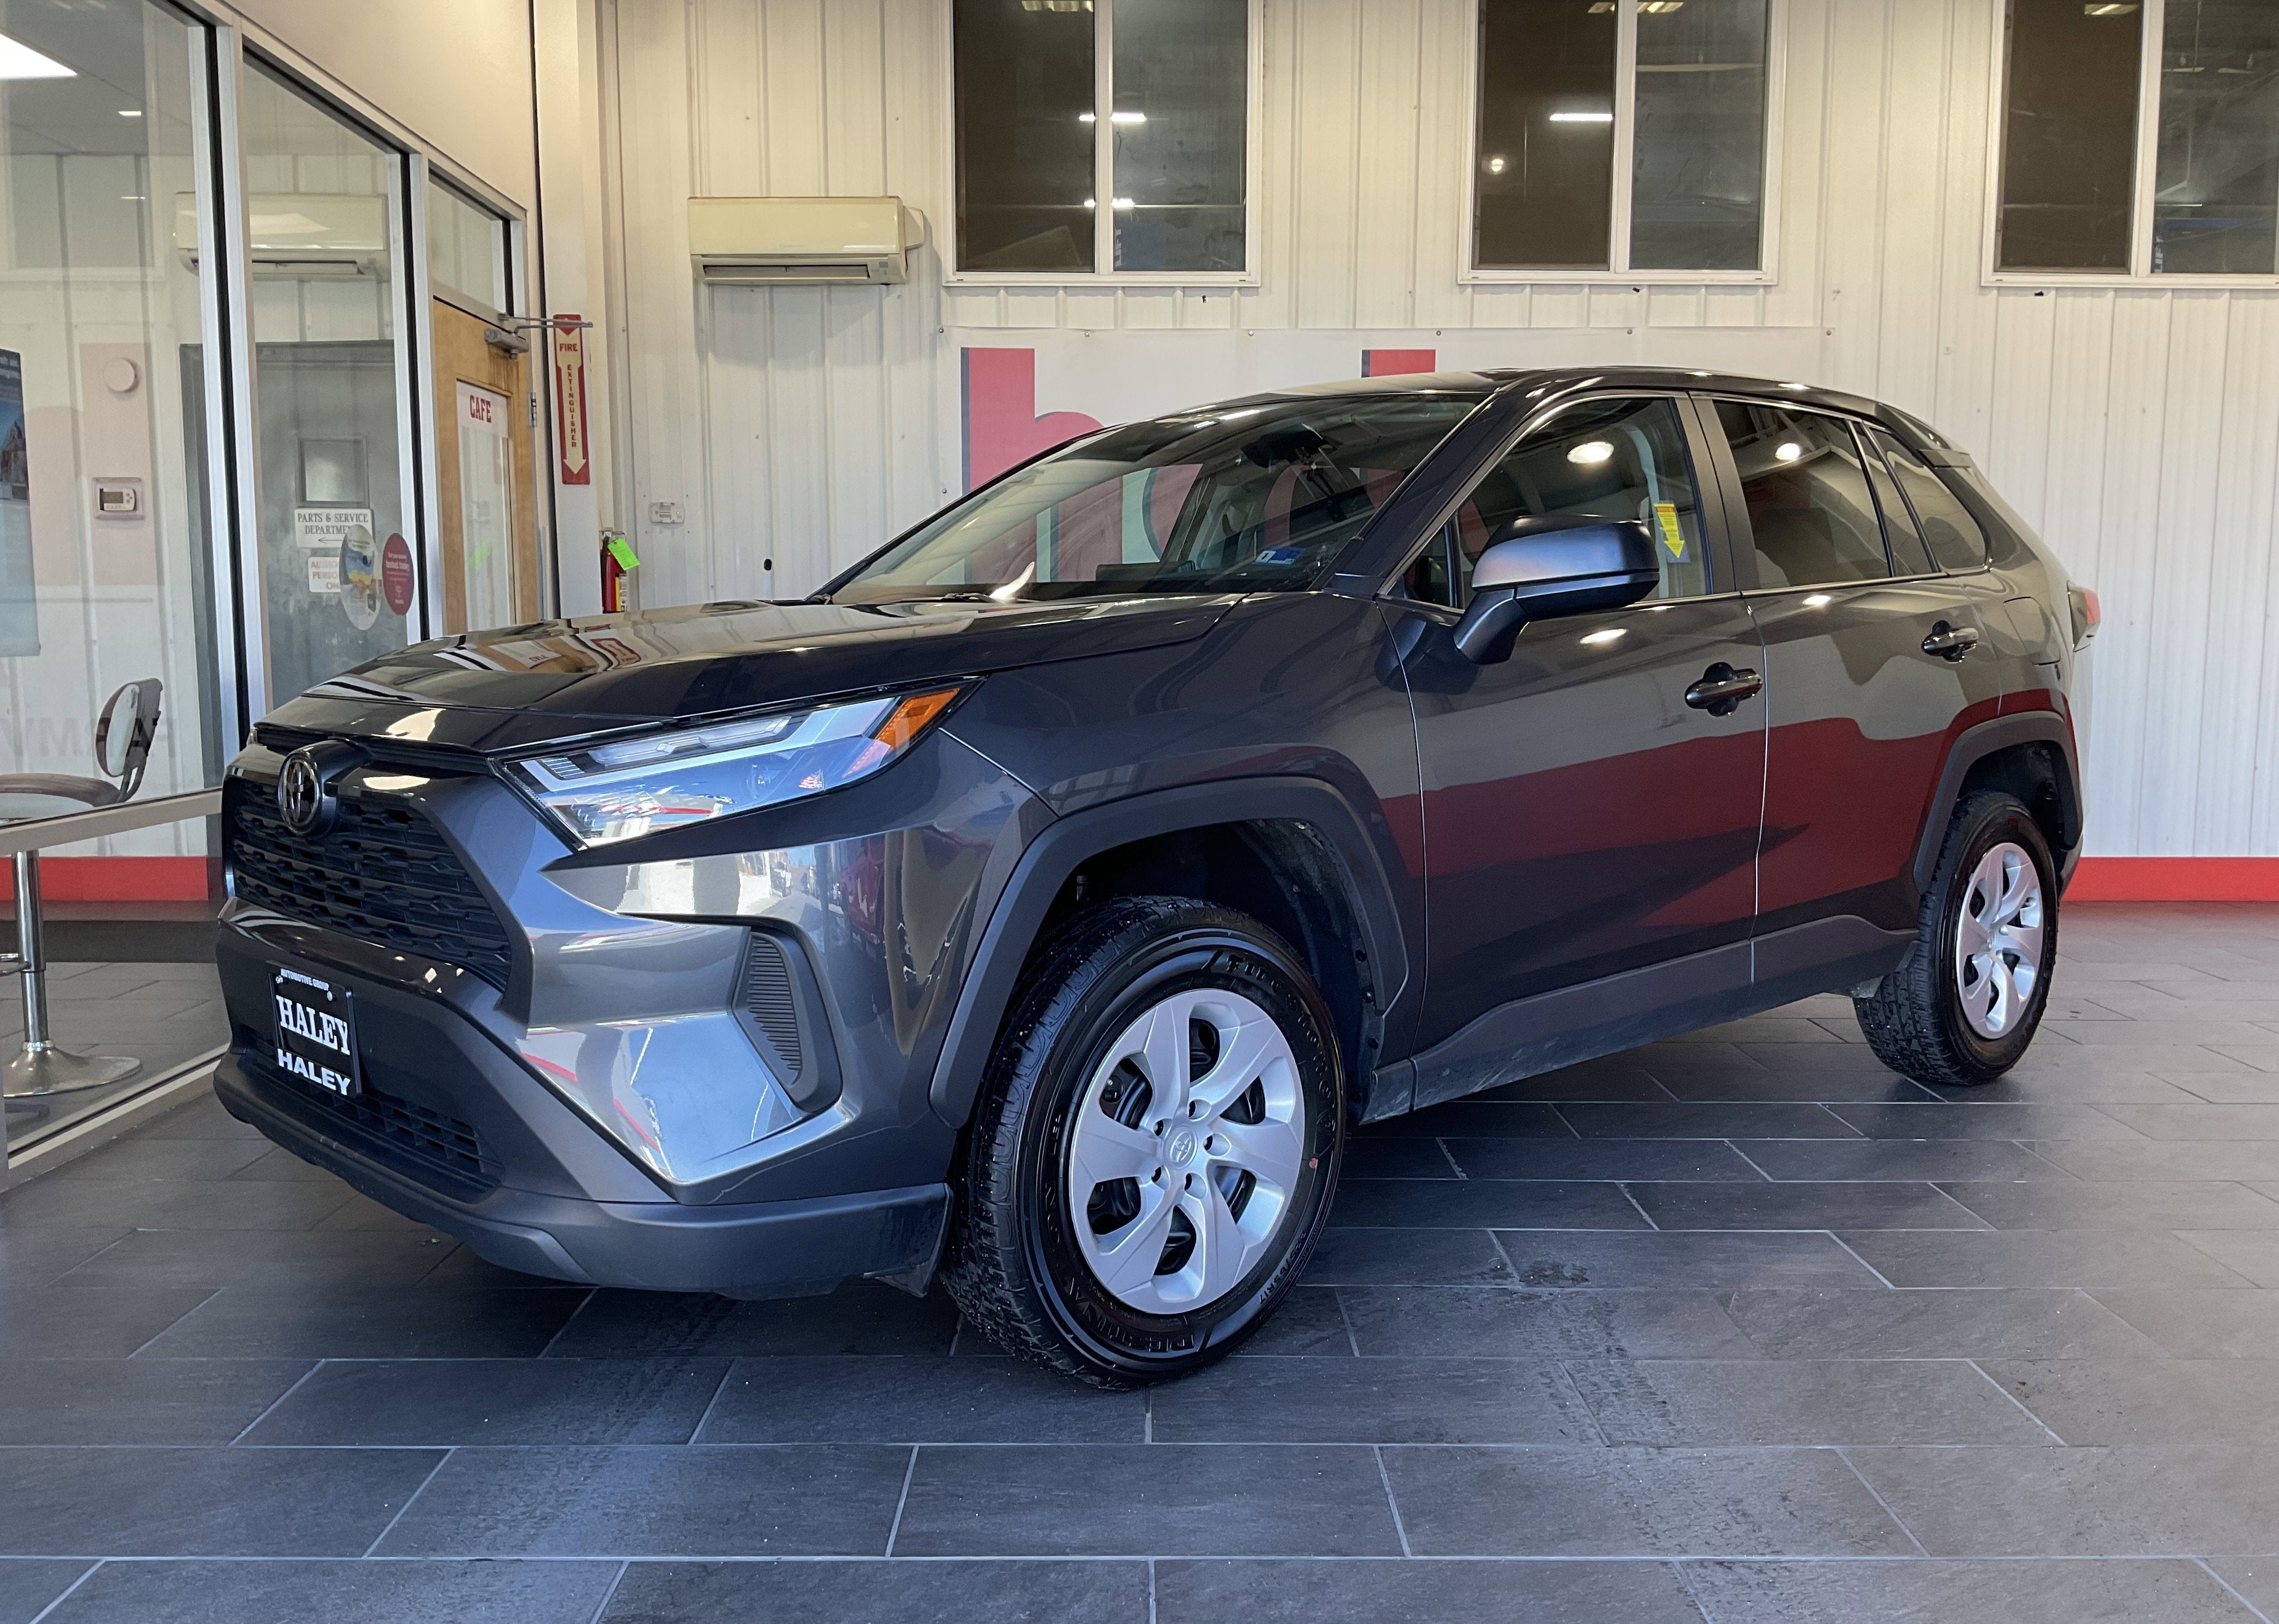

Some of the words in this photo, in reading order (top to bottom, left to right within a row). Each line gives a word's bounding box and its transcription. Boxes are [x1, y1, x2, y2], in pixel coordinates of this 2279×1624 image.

[559, 343, 578, 352] FIRE
[470, 394, 492, 423] CAFE
[567, 364, 577, 448] EXTINGUISHER
[297, 513, 323, 523] PARTS
[334, 513, 369, 523] SERVICE
[305, 525, 350, 535] DEPARTME
[276, 995, 350, 1056] HALEY
[278, 1048, 351, 1096] HALEY
[1259, 1230, 1307, 1304] 225/65R17
